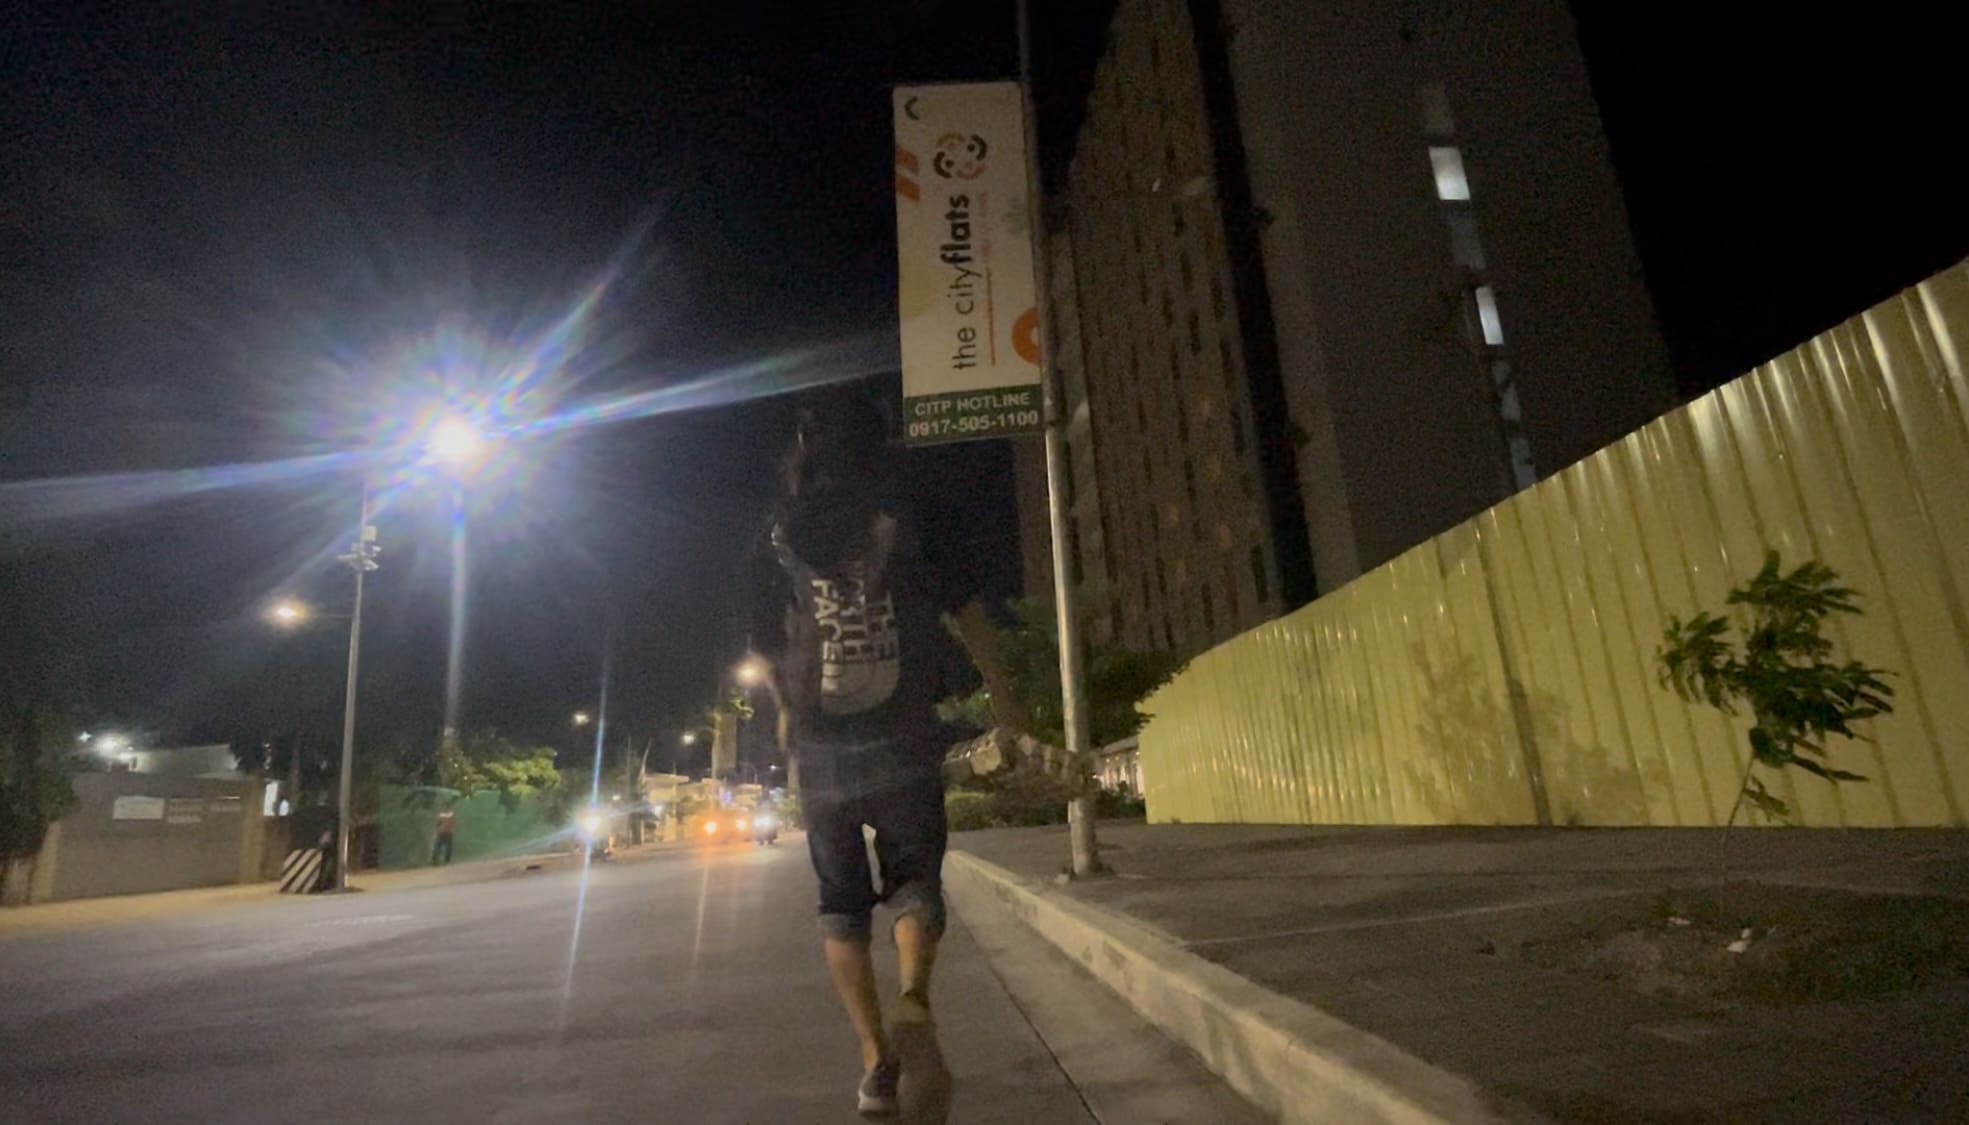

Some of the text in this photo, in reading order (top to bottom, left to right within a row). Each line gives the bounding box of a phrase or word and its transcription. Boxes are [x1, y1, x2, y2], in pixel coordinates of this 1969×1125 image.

[939, 194, 982, 370] the cityflats
[909, 411, 1039, 437] 0917-505-1100
[915, 392, 1031, 416] CITP HOTLINE
[811, 579, 844, 662] FACE
